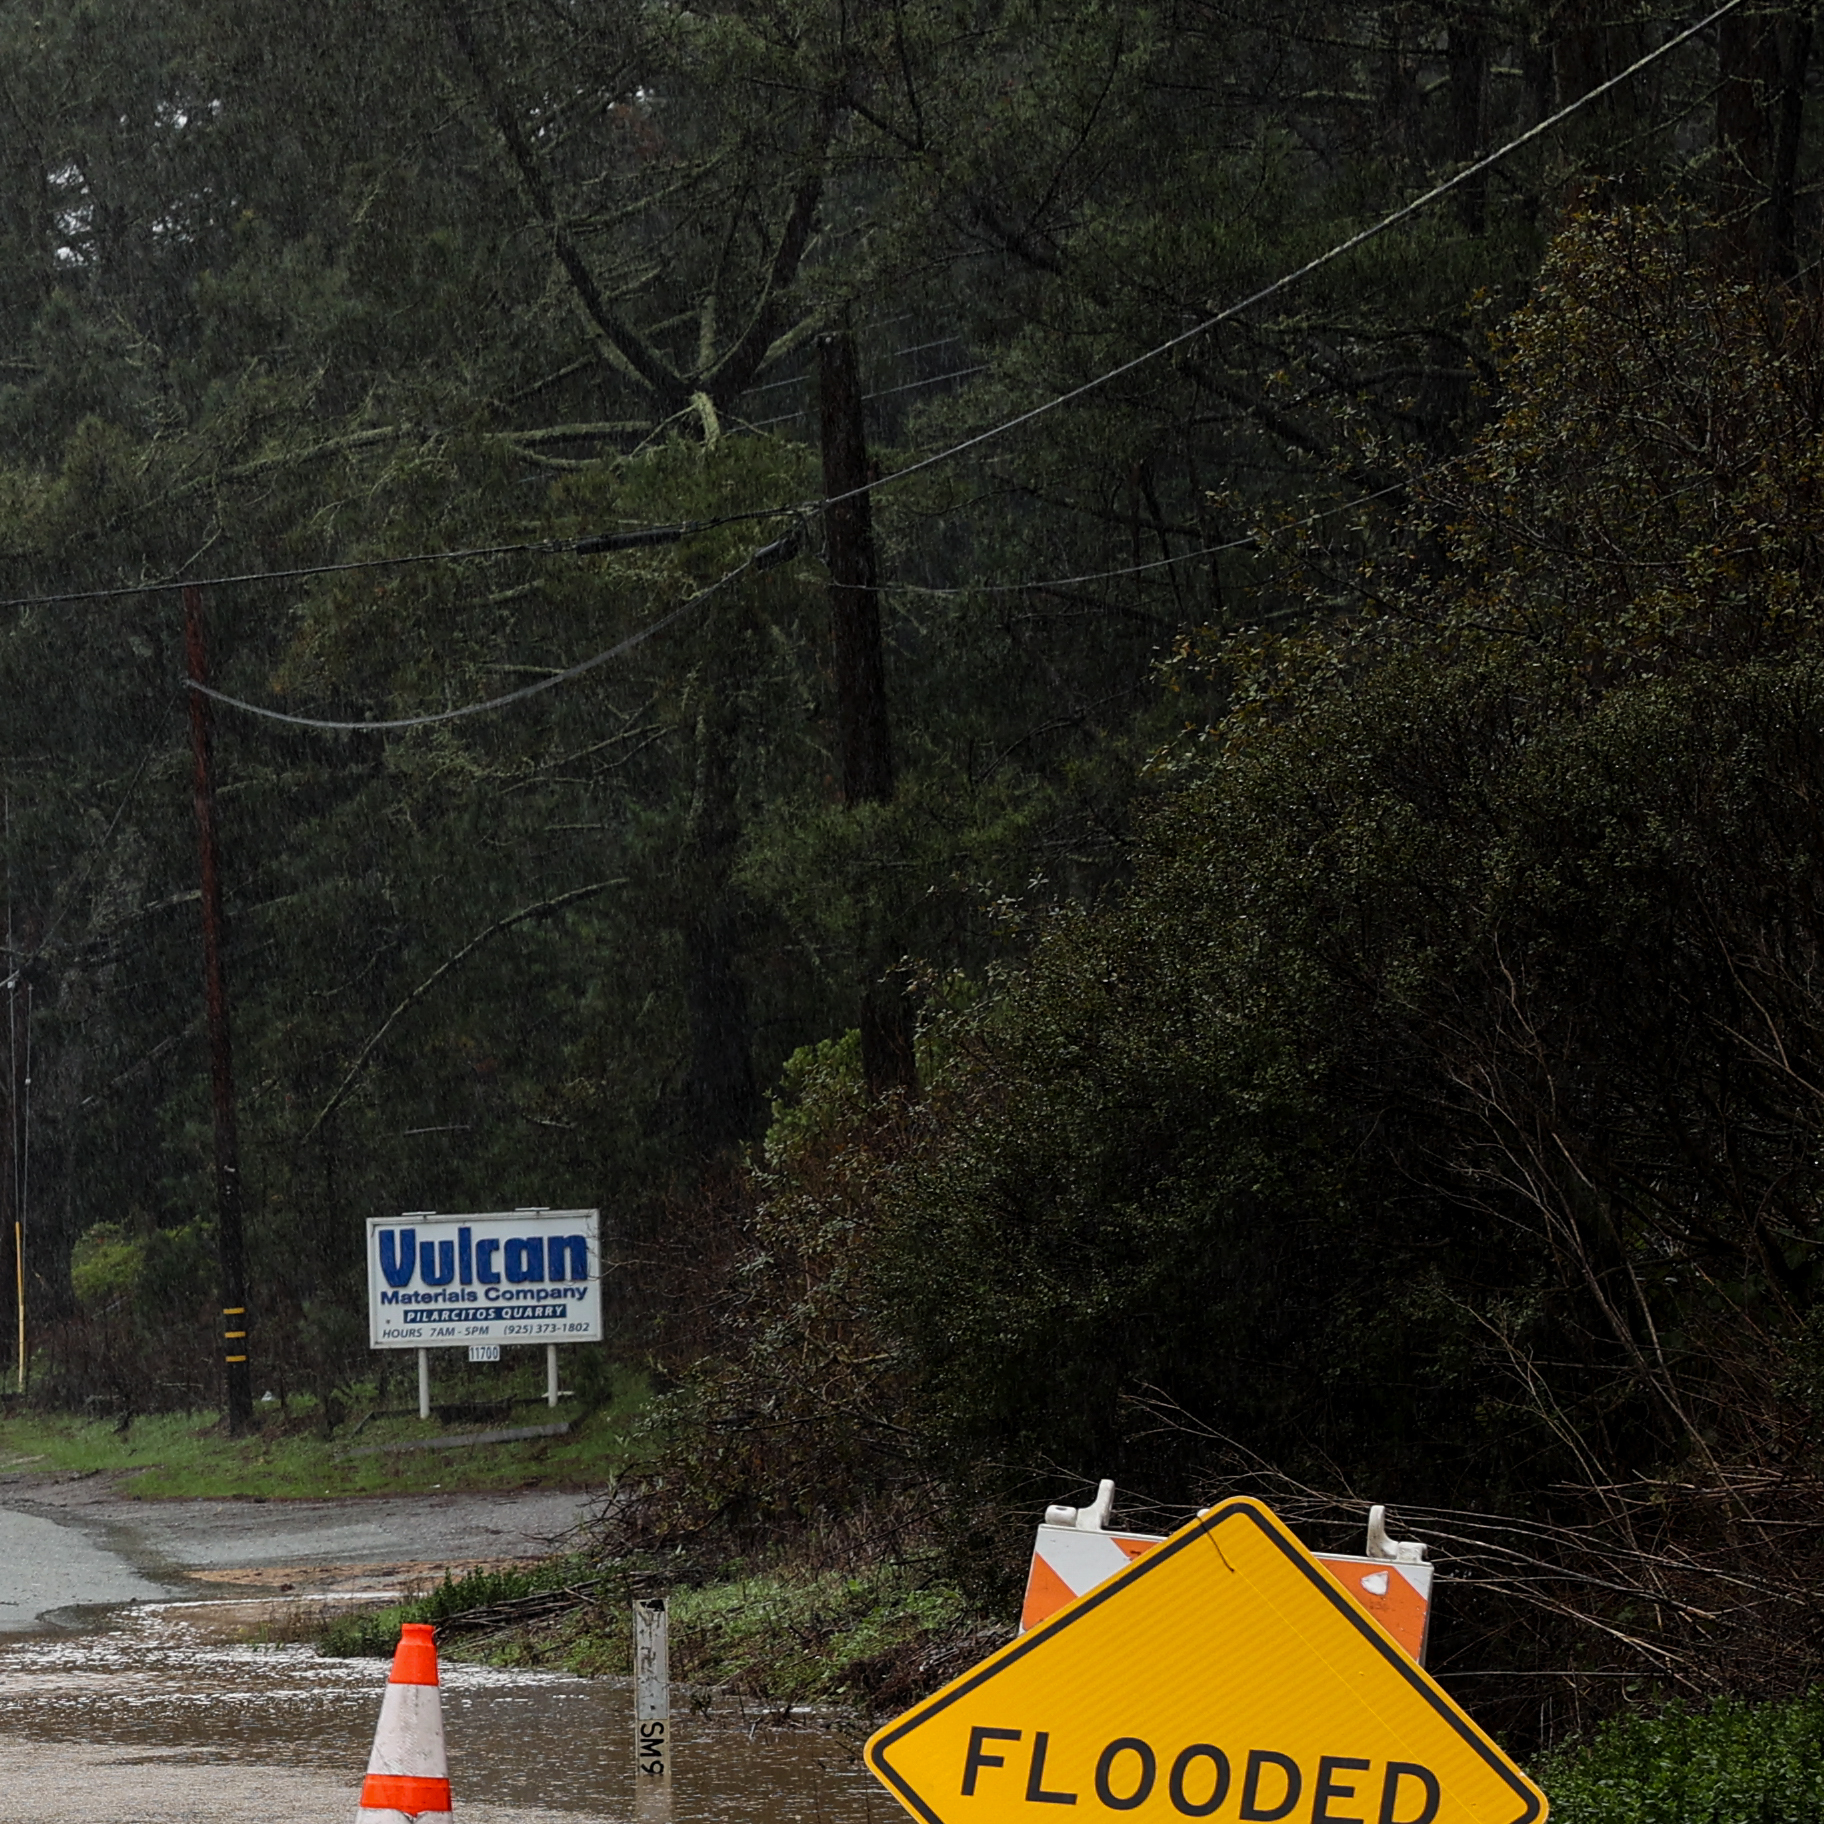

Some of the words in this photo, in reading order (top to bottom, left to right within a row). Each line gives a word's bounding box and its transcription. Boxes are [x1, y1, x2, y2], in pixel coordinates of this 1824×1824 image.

[378, 1226, 588, 1288] Vulcan
[380, 1287, 478, 1305] Materials
[484, 1286, 588, 1303] Company
[406, 1309, 496, 1322] PILARCITOS
[501, 1306, 564, 1319] QUARRY
[382, 1327, 422, 1338] HOURS
[430, 1326, 456, 1337] 7AM
[464, 1325, 490, 1336] 5PM
[503, 1324, 533, 1335] (925)
[535, 1322, 590, 1334] 373-1802
[469, 1346, 499, 1360] 11700
